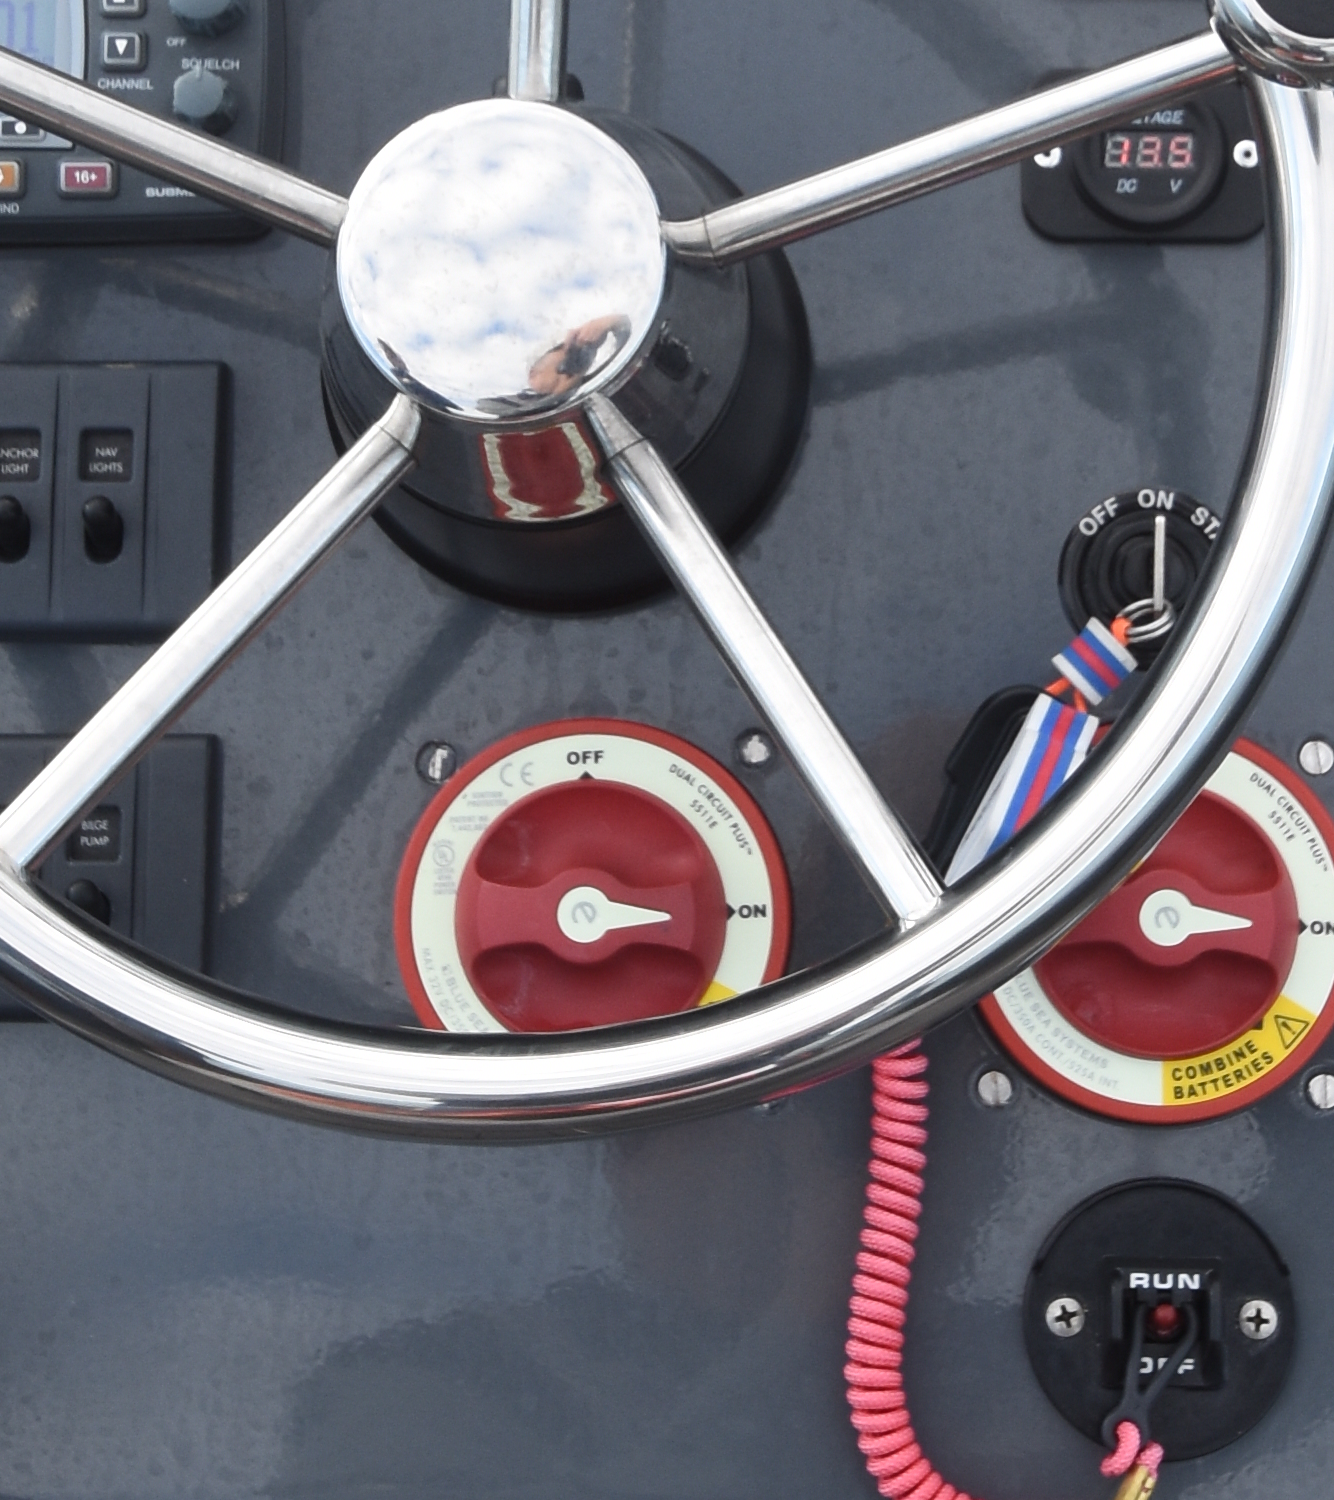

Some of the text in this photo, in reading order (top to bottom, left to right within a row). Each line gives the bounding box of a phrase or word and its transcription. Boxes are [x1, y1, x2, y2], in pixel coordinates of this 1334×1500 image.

[166, 37, 187, 47] OFF
[181, 58, 240, 70] SQUELCH
[97, 78, 154, 90] CHANNEL
[73, 171, 98, 184] 16+
[1116, 178, 1183, 193] DC V
[95, 446, 119, 458] NAV
[1, 463, 29, 475] LIGHT
[89, 462, 124, 475] LIGHTS
[1138, 488, 1174, 510] ON
[1078, 497, 1119, 537] OFF
[567, 750, 604, 766] OFF
[669, 763, 734, 822] DUAL CIRCUIT
[1249, 772, 1311, 836] DUAL CIRCUIT
[81, 819, 109, 831] BILGE
[79, 836, 110, 847] PUMP
[738, 904, 767, 919] ON
[446, 976, 471, 1011] BLUE
[1030, 1003, 1109, 1069] SEA SYSTEMS
[1171, 1040, 1259, 1081] COMBINE
[1174, 1051, 1274, 1099] BATTERIES
[1129, 1272, 1200, 1290] RUN
